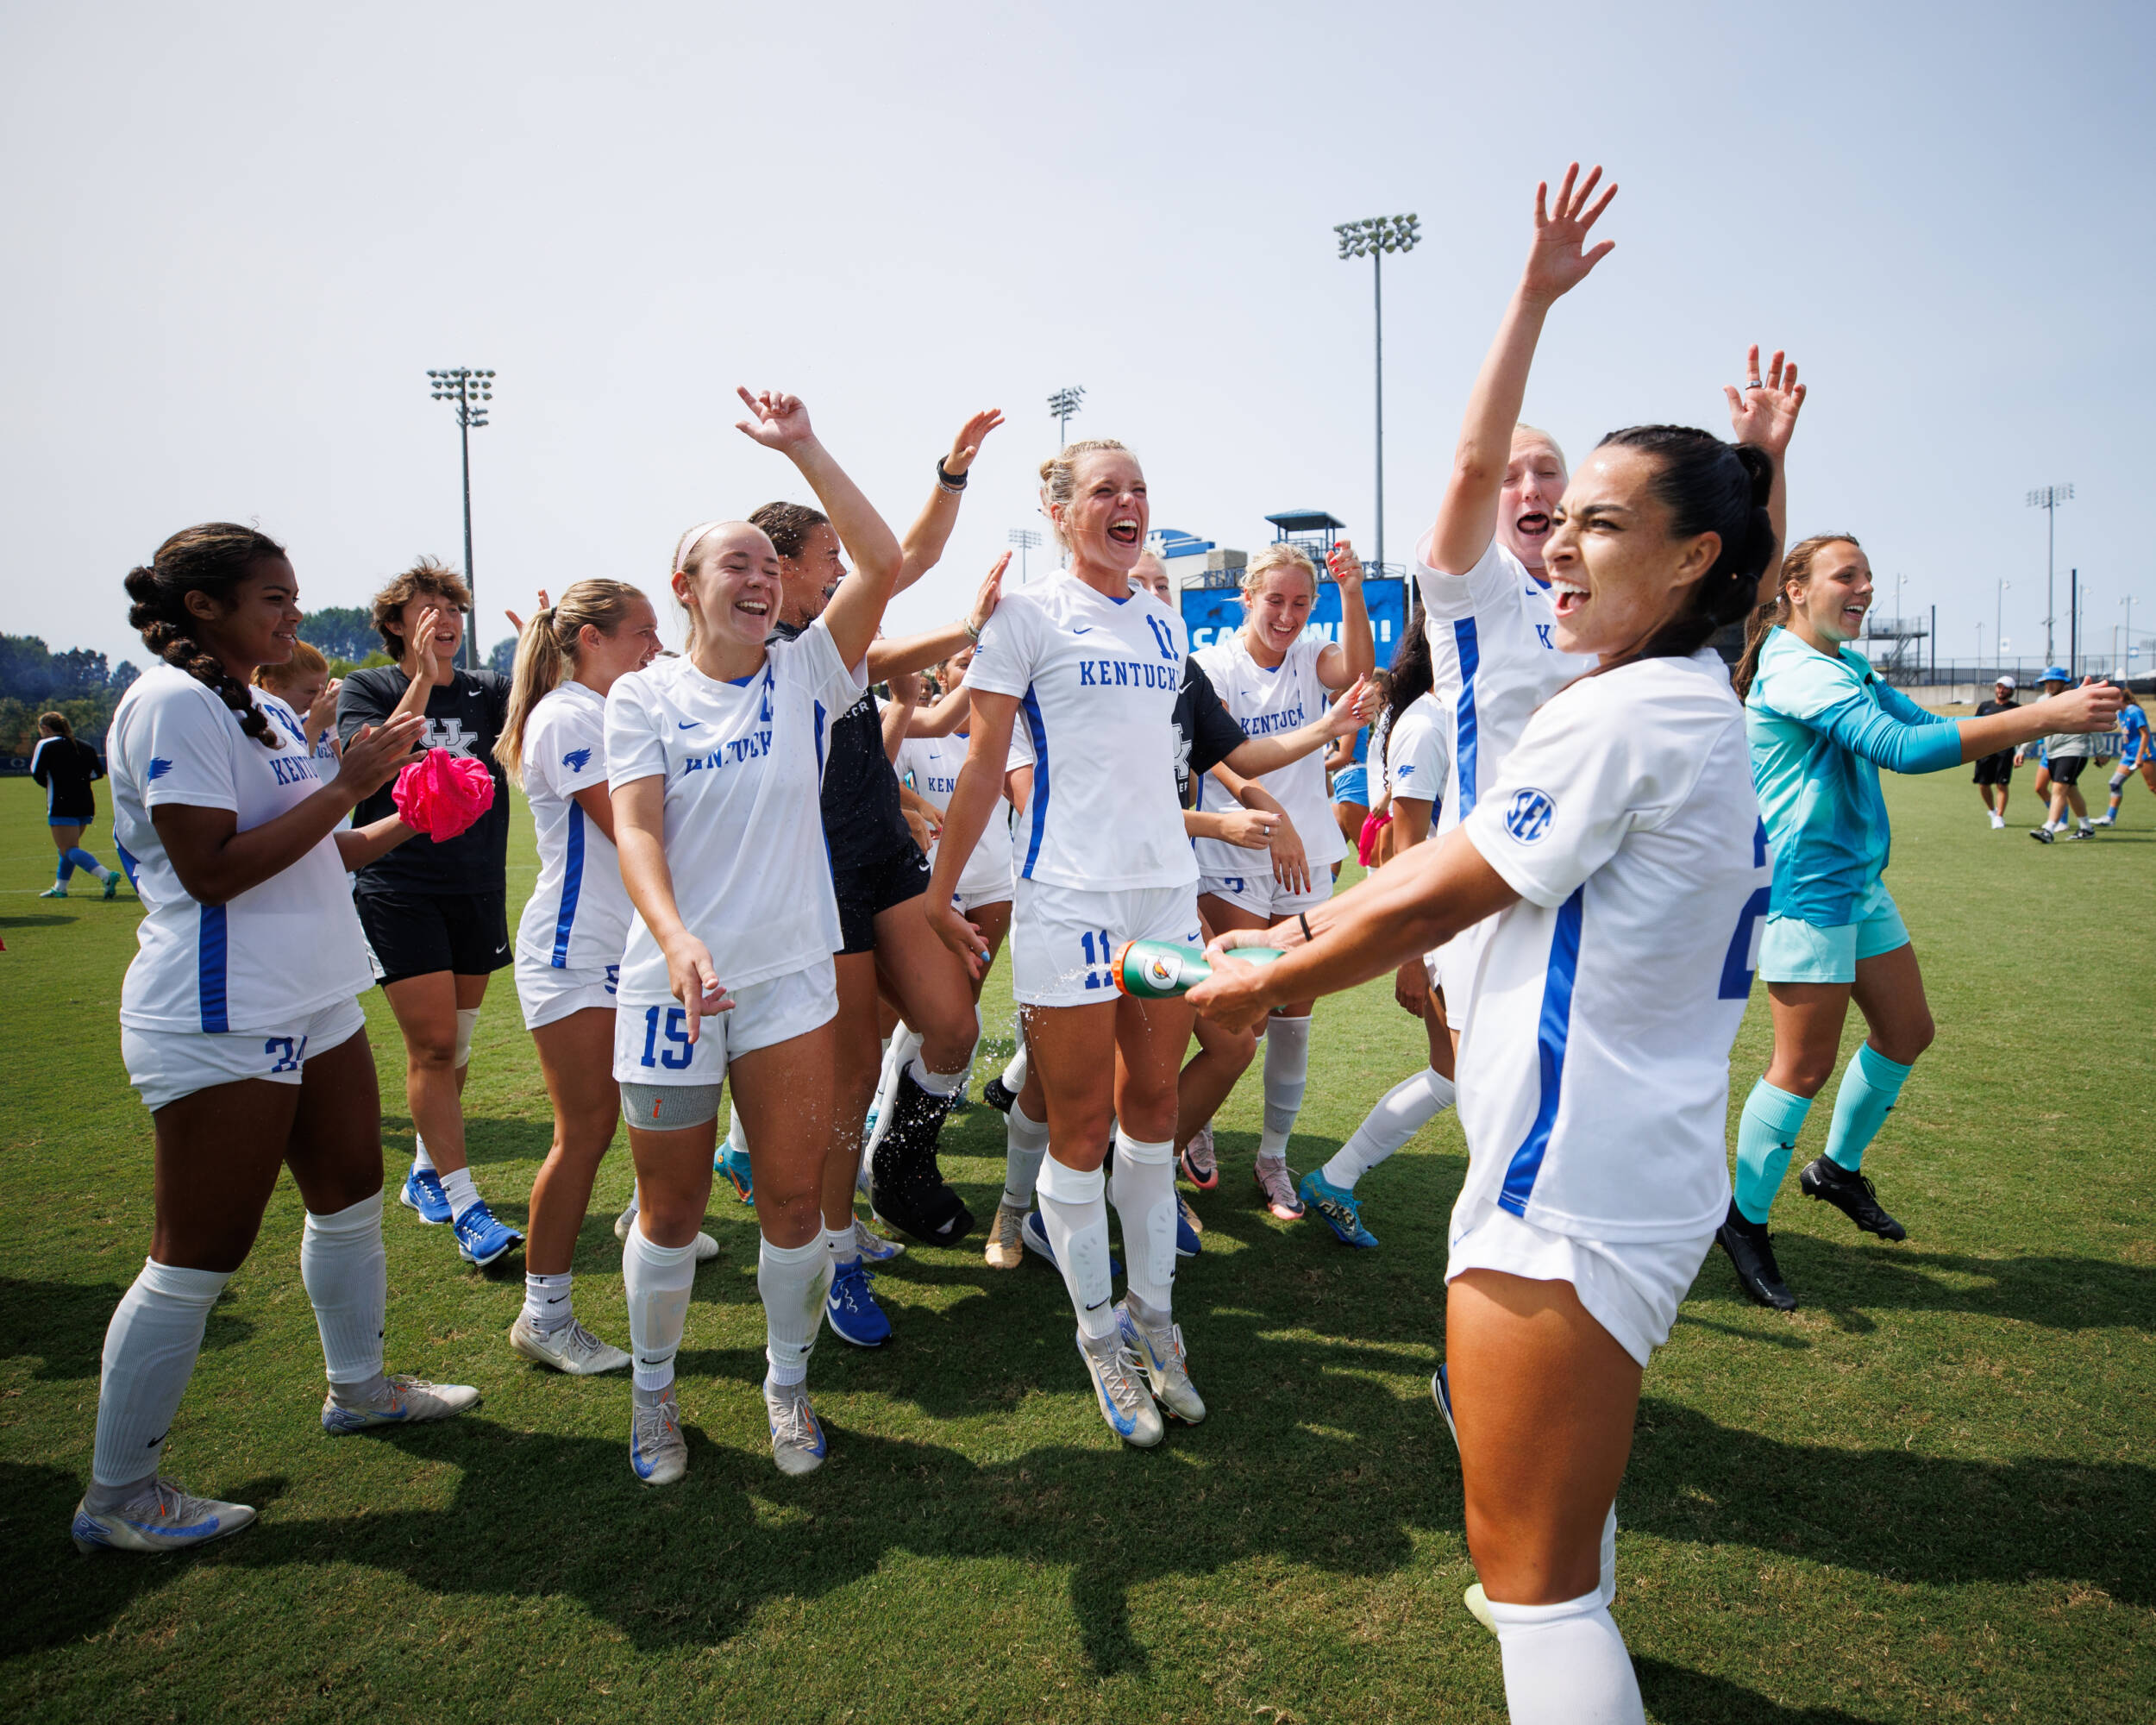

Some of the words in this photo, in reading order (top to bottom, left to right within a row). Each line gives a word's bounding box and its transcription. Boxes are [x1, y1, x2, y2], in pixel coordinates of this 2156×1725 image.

[1079, 661, 1181, 692] KENTUCK
[1507, 791, 1552, 841] SEC
[1081, 929, 1114, 989] 11
[640, 1006, 694, 1070] 15
